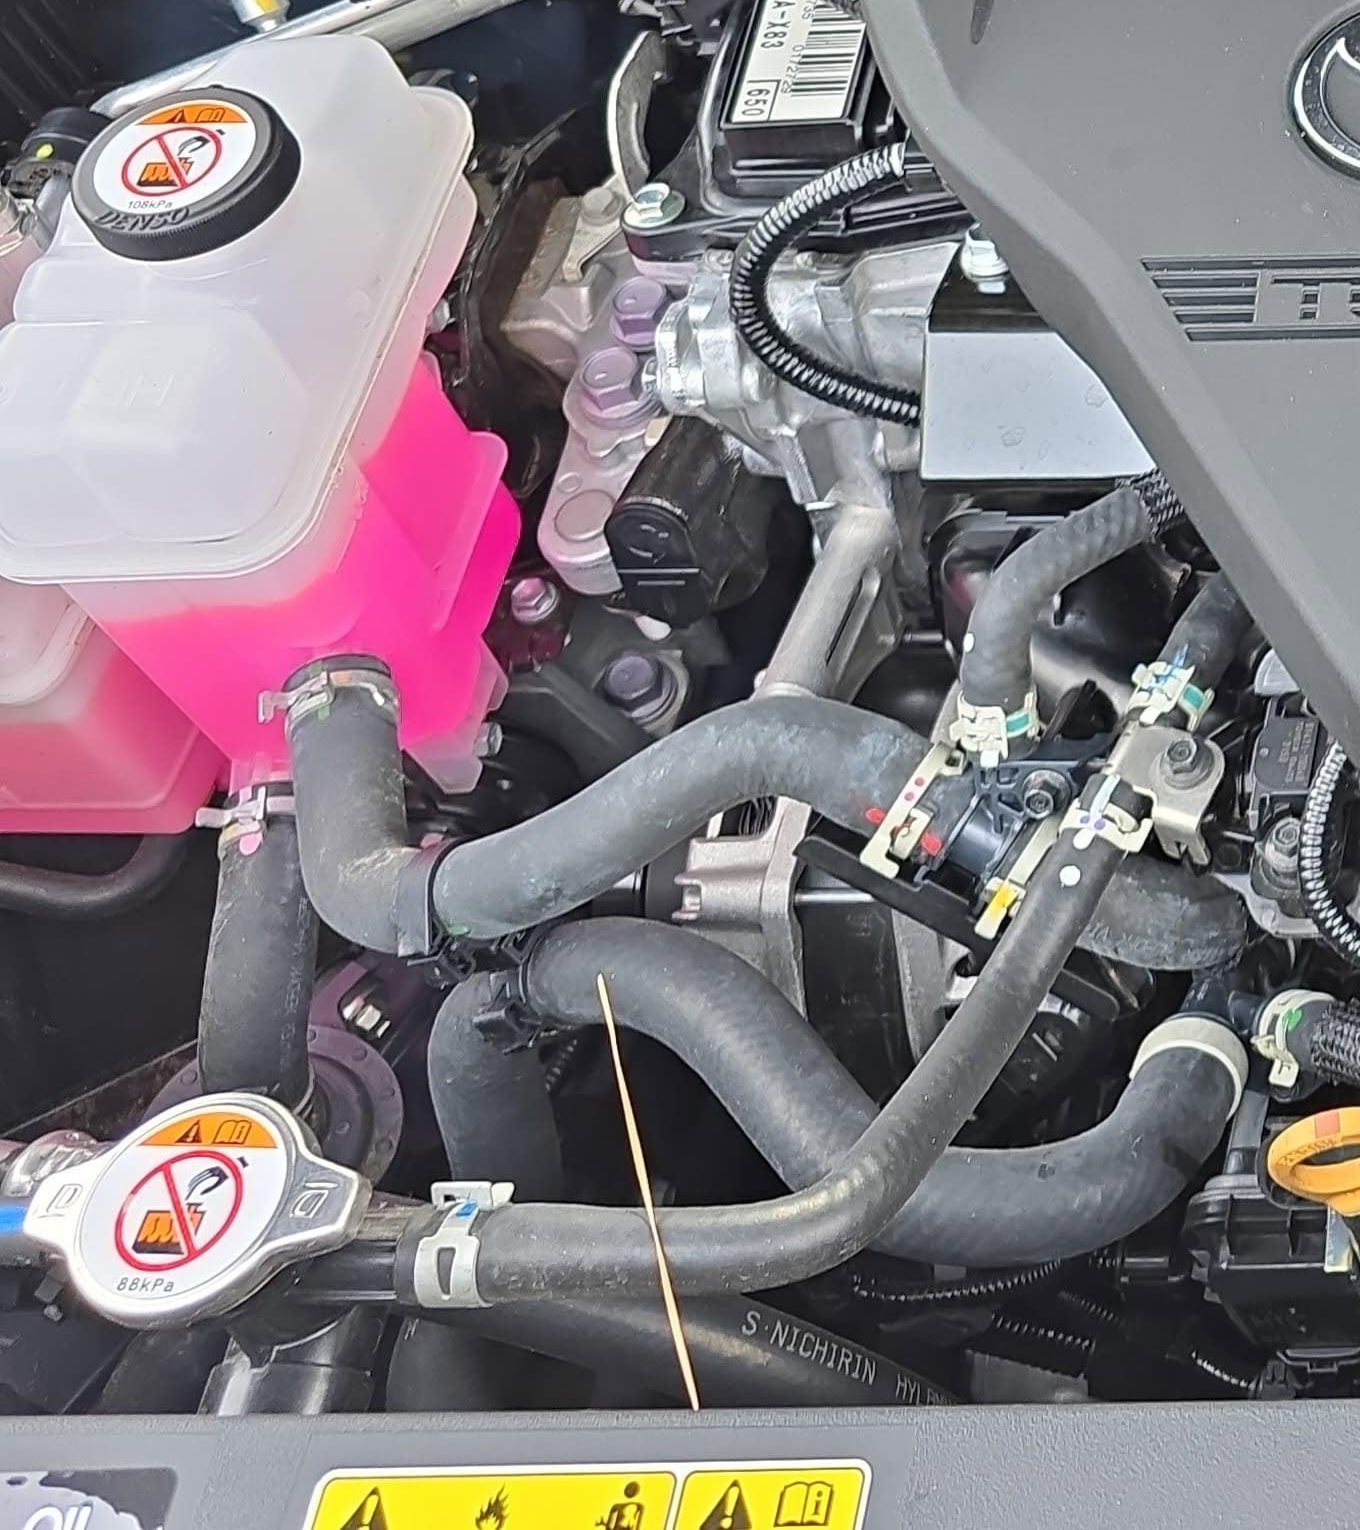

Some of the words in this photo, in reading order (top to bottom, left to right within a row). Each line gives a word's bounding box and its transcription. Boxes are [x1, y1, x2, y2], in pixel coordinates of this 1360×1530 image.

[742, 88, 770, 116] 650
[127, 201, 174, 210] 108kPa
[95, 206, 191, 232] DENSO
[117, 1277, 175, 1292] 88kPa
